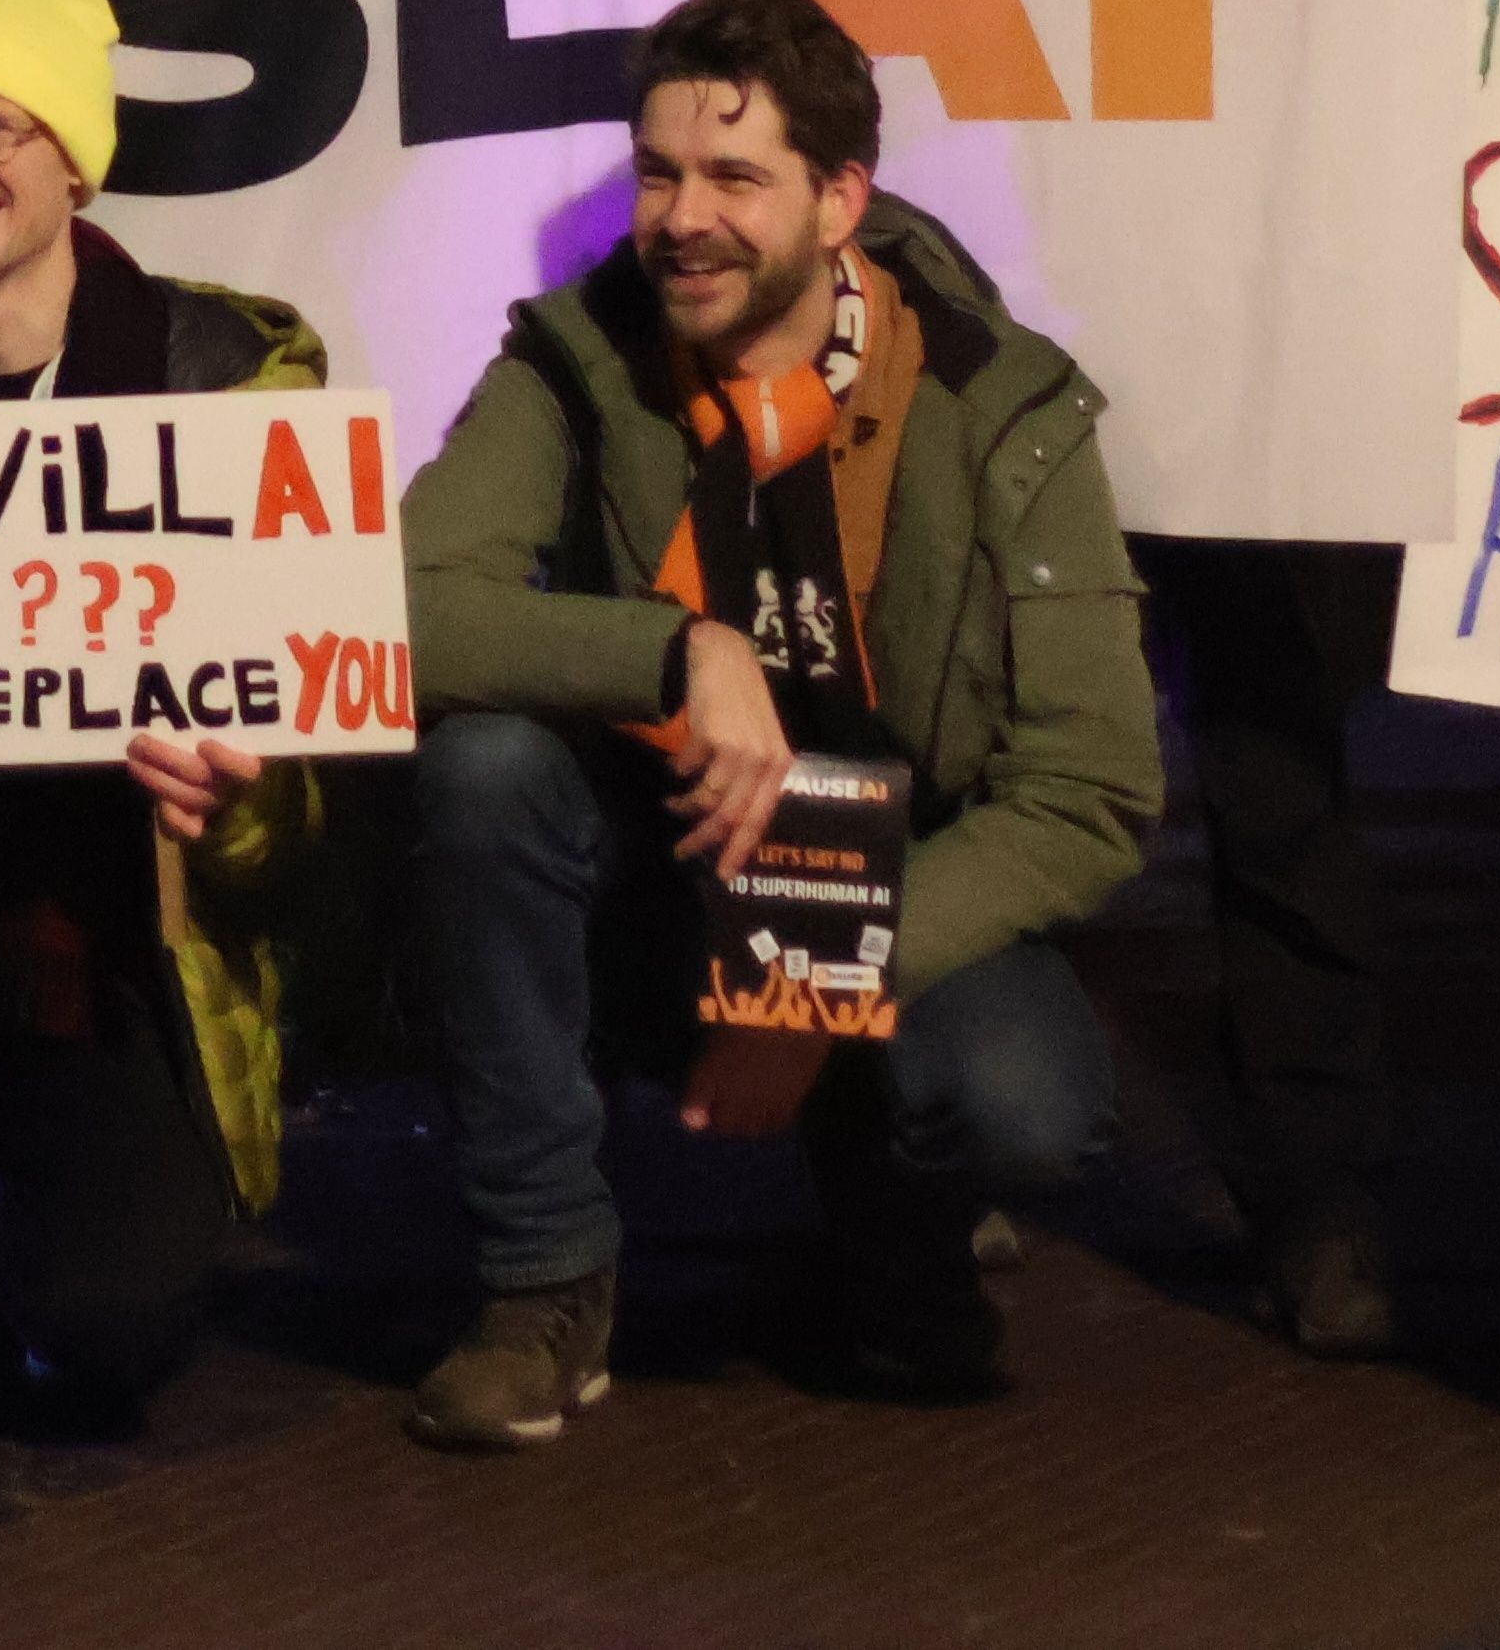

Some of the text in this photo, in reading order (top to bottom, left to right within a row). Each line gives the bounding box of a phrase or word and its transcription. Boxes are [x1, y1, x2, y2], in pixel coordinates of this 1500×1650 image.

[251, 416, 387, 541] AI
[12, 558, 177, 653] ???
[284, 629, 416, 737] YOU
[751, 875, 869, 903] SUPERHUMAN
[871, 885, 891, 906] AI
